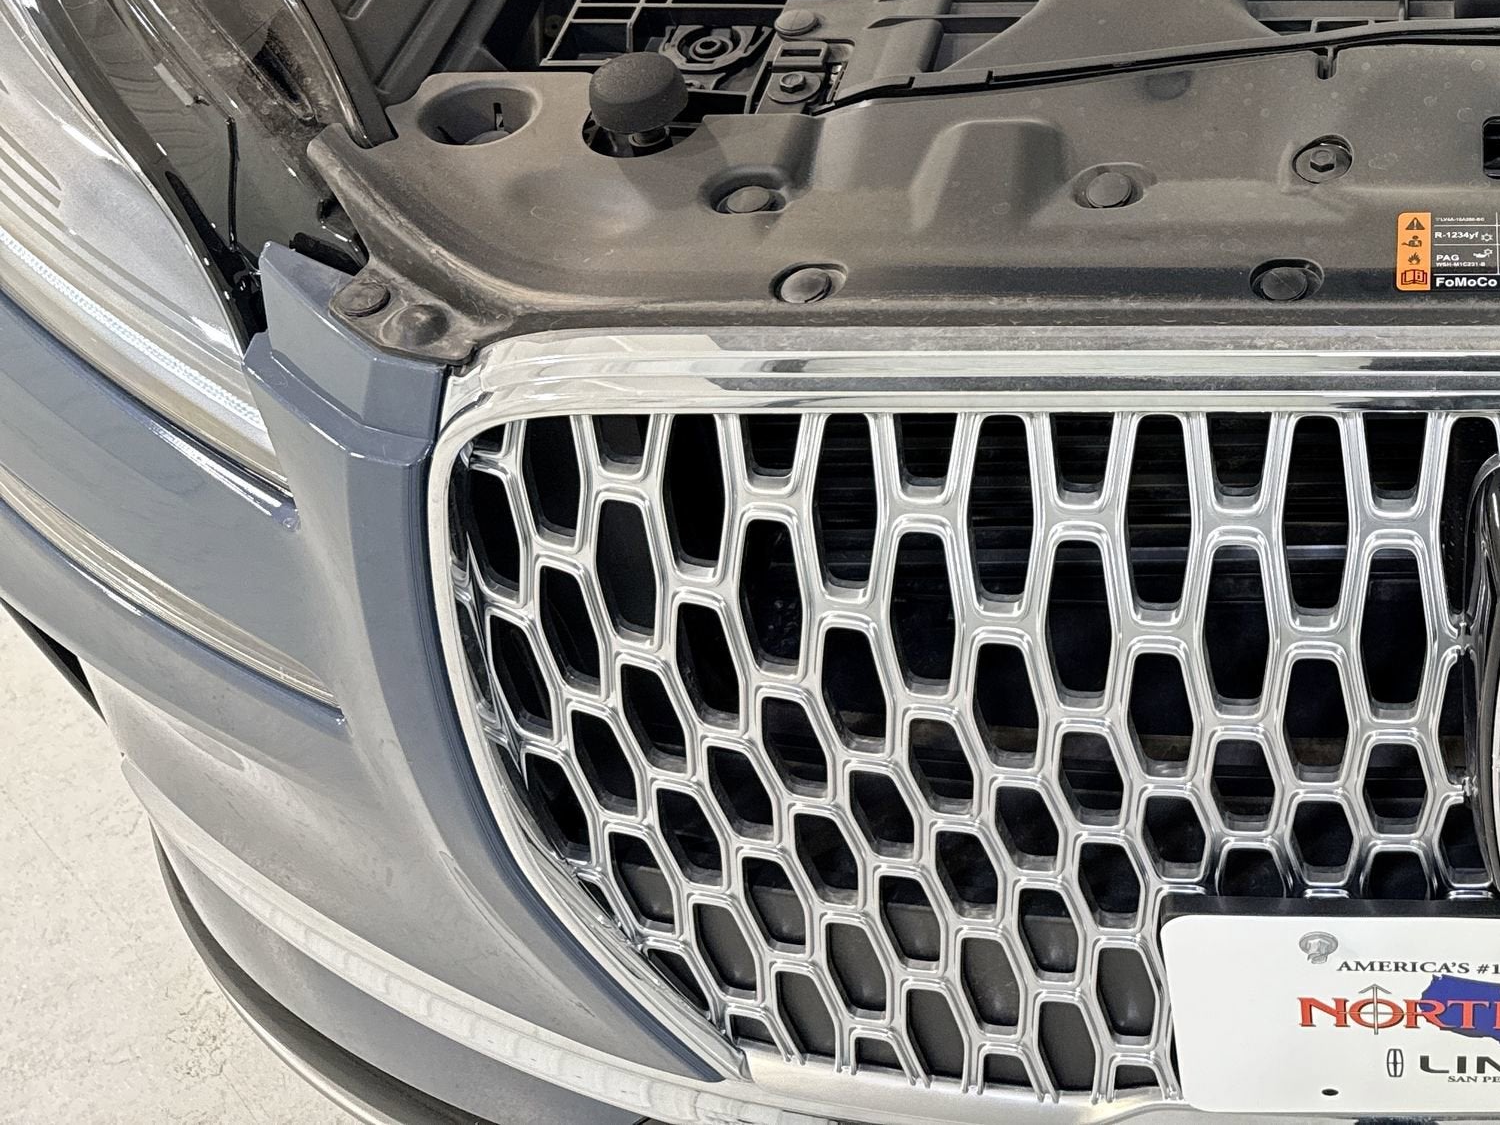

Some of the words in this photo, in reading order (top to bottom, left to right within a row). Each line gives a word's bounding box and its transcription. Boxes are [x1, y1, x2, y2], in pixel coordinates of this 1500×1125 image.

[1434, 231, 1479, 239] R-1234yf
[1435, 277, 1498, 287] FoMoCo
[1336, 961, 1470, 973] AMERICA'S
[1448, 1075, 1477, 1083] SAN
